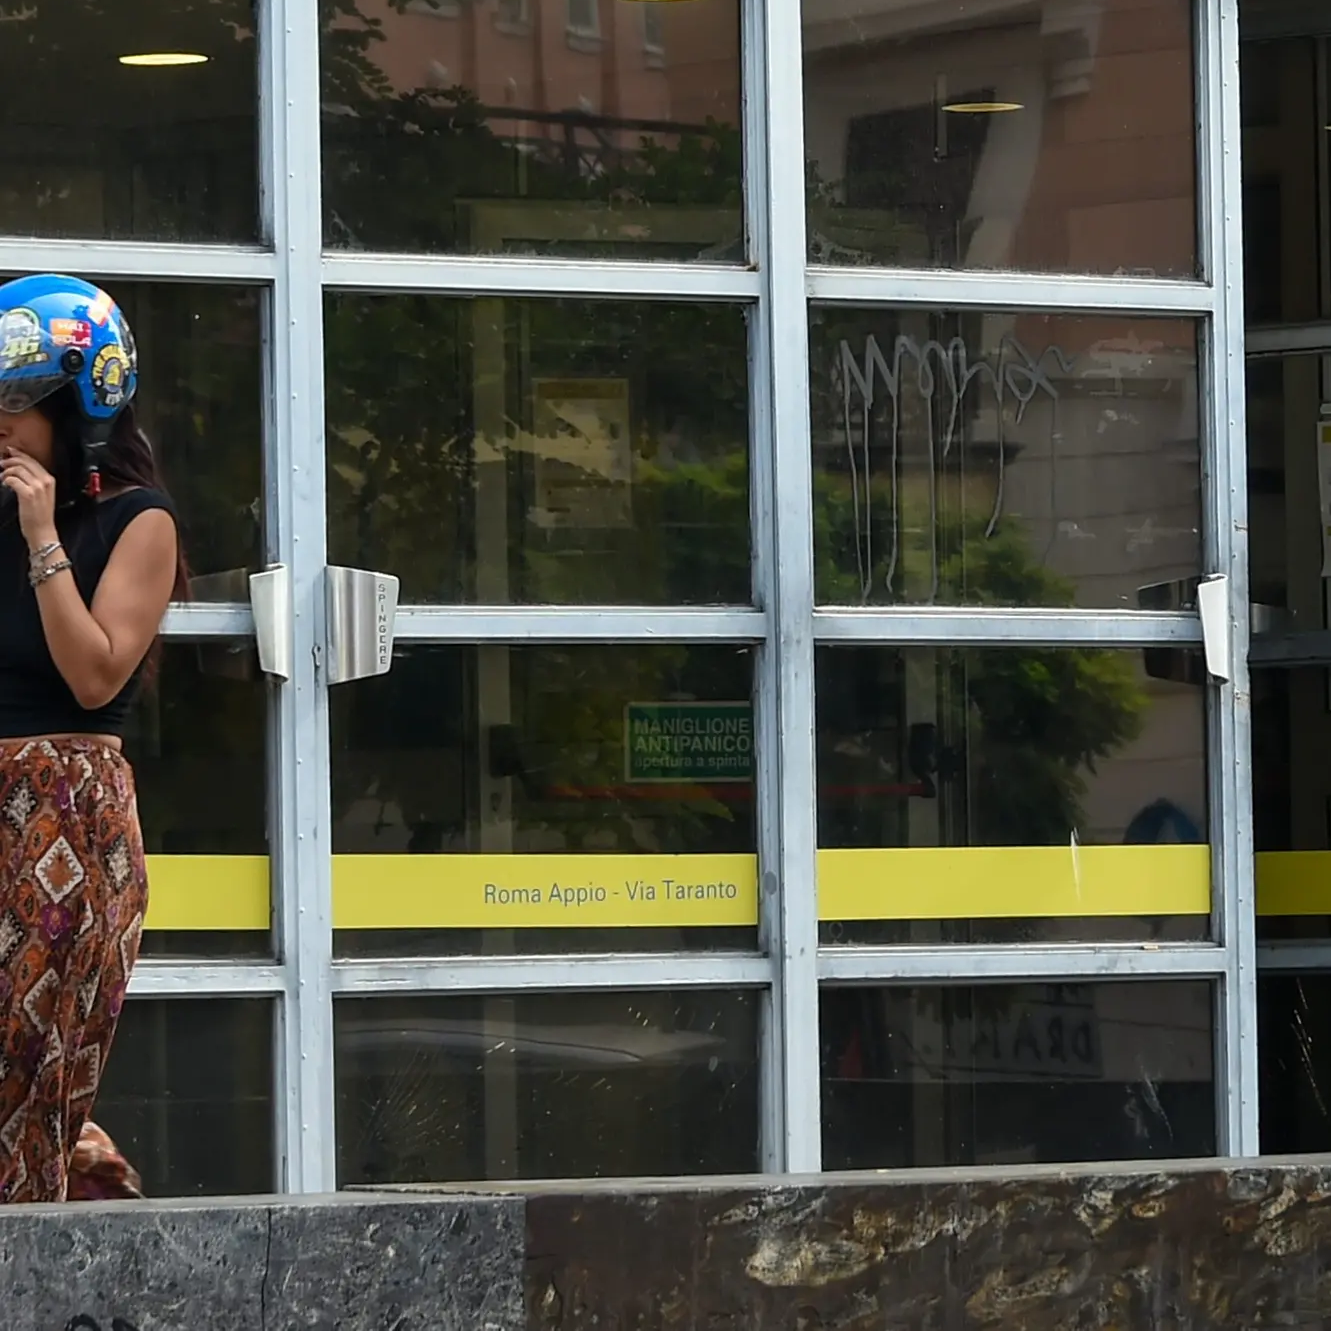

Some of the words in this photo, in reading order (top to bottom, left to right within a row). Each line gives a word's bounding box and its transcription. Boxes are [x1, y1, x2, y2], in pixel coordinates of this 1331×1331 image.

[378, 583, 387, 664] SPINGERE
[634, 717, 750, 735] MANIGLIONE
[634, 735, 751, 753] ANTIPANICO
[634, 755, 693, 770] apertura
[696, 756, 705, 767] a
[708, 753, 751, 770] spinta
[484, 883, 541, 905] Roma
[548, 882, 607, 907] Appio
[625, 880, 656, 901] Via
[662, 879, 737, 900] Taranto
